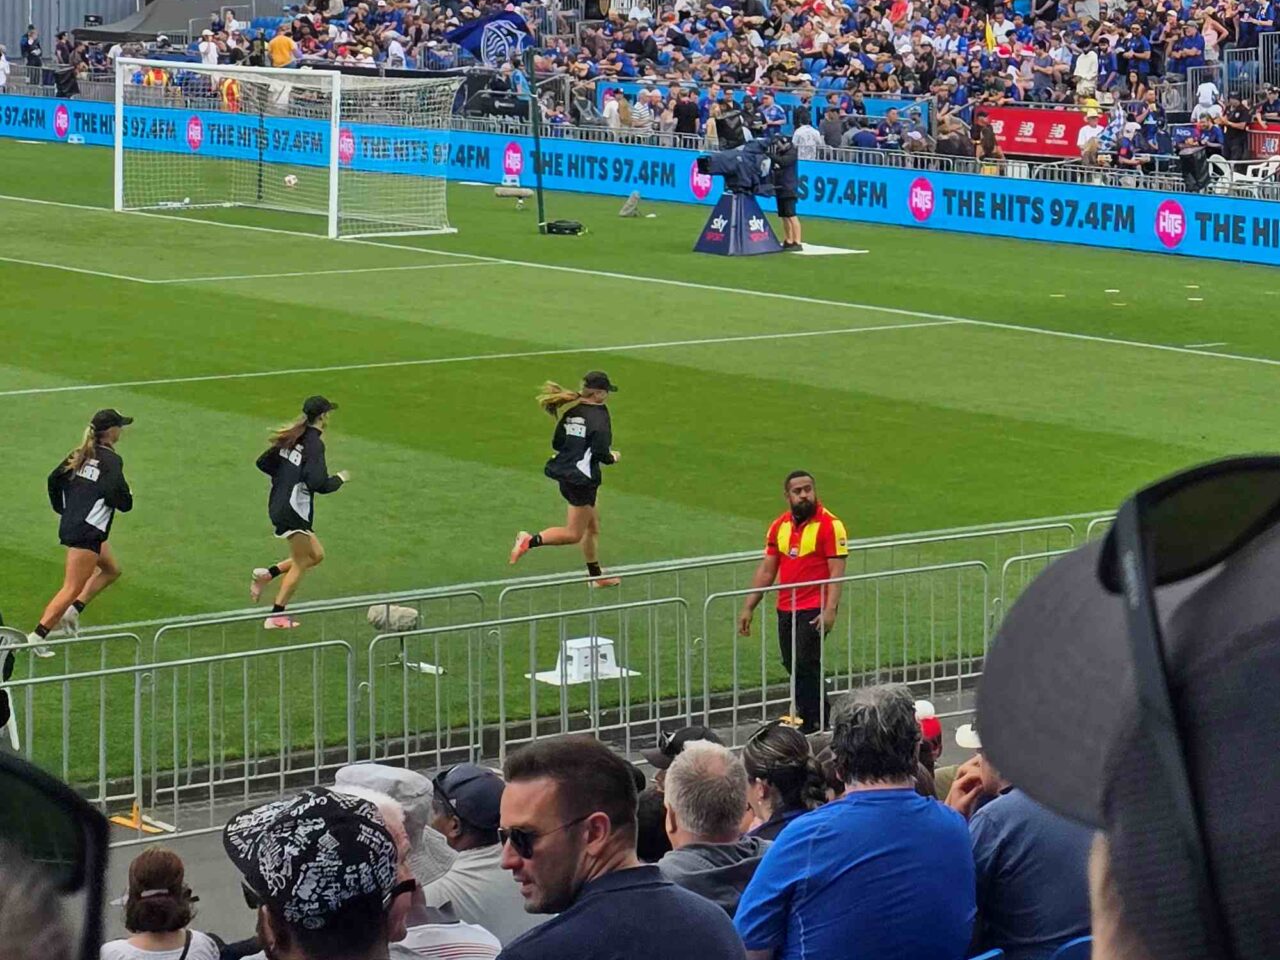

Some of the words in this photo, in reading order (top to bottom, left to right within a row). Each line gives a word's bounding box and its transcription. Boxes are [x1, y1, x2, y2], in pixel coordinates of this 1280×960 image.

[5, 106, 46, 129] 97.4FM
[74, 112, 97, 133] THE
[208, 123, 234, 145] THE
[568, 153, 609, 180] HITS
[613, 157, 676, 187] 97.4FM
[814, 177, 888, 209] 97.4FM
[943, 188, 985, 219] THE
[991, 193, 1044, 225] HITS
[1050, 199, 1135, 233] 97.4FM
[711, 214, 728, 232] sky
[749, 215, 764, 232] sky
[1195, 212, 1246, 245] THE
